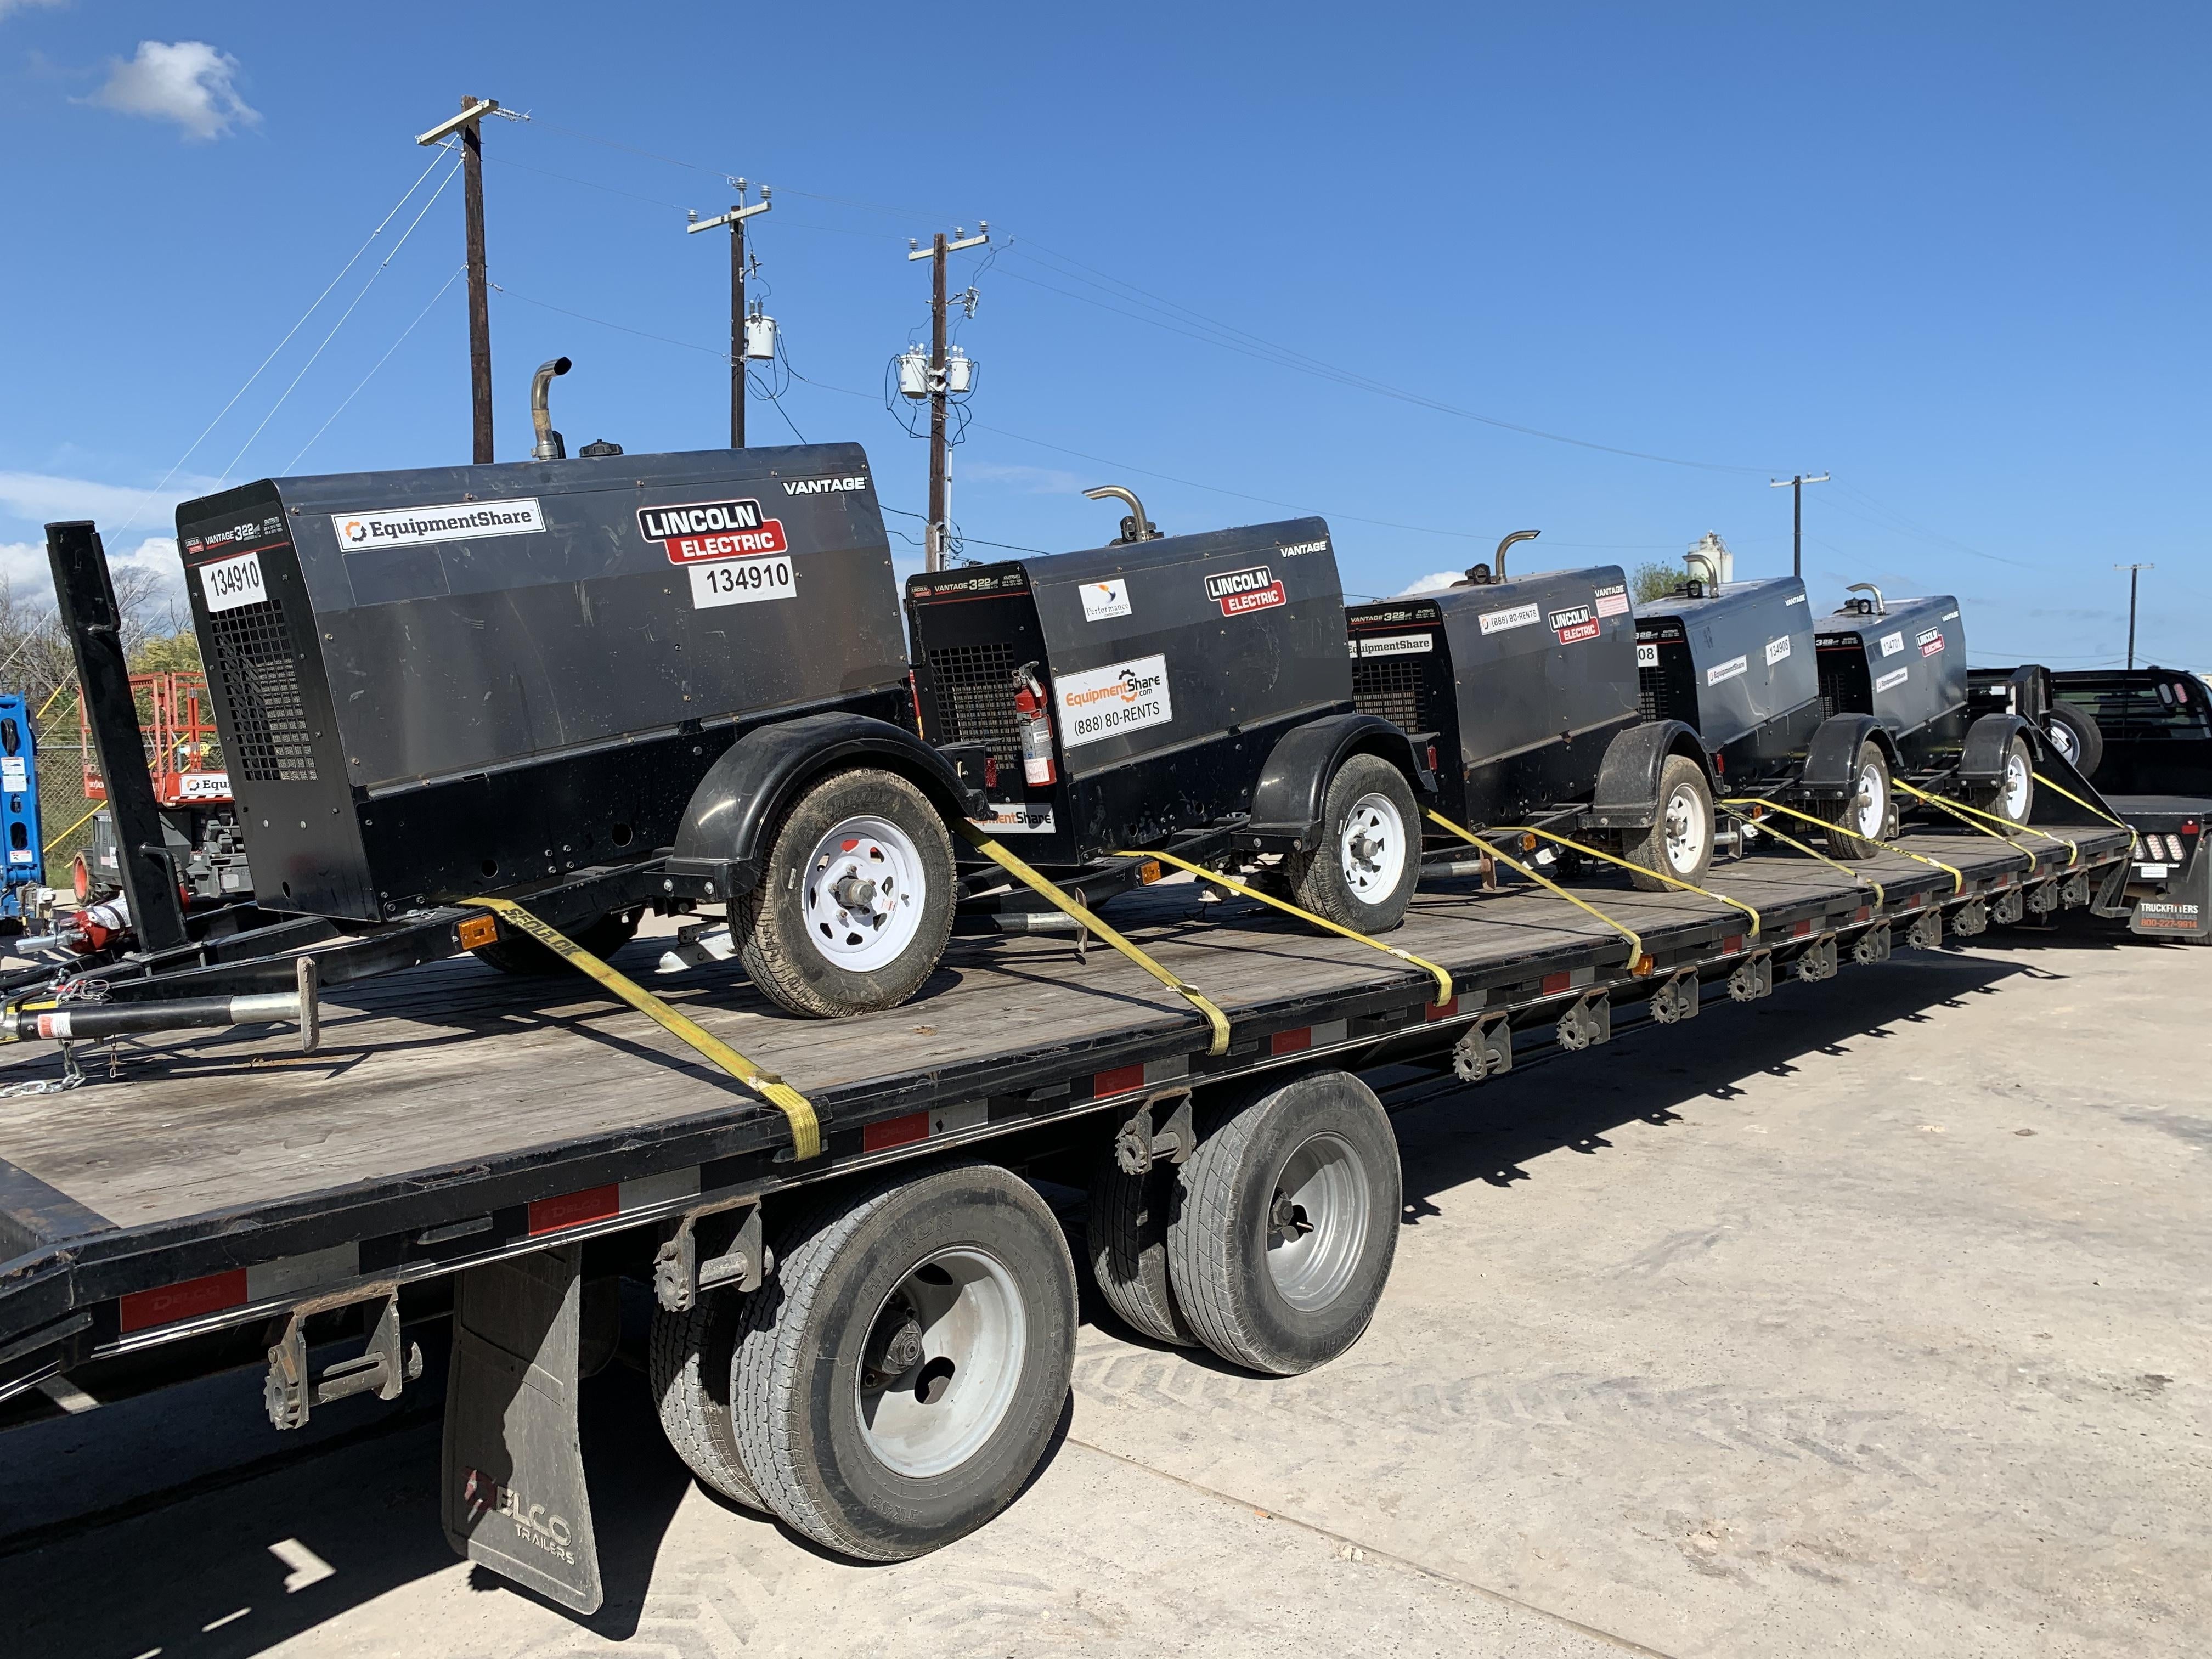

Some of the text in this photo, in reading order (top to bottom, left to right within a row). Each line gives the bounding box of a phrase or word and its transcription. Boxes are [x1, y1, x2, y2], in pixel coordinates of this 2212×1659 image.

[782, 476, 866, 495] VANTAGE
[370, 510, 532, 538] EquipmentShare
[646, 506, 757, 537] LINCOLN
[205, 531, 234, 545] VANTAGE
[234, 523, 253, 541] 322
[680, 533, 774, 558] ELECTRIC
[1280, 541, 1327, 558] VANTAGE
[211, 561, 259, 596] 134910
[706, 563, 789, 594] 134910
[935, 582, 968, 592] VANTAGE
[969, 578, 991, 590] 322
[1209, 571, 1269, 597] LINCOLN
[1595, 585, 1624, 597] VANTAGE
[1785, 594, 1805, 606] VANTAGE
[1086, 603, 1128, 616] Performance
[1228, 590, 1279, 611] ELECTRIC
[1351, 614, 1383, 623] VANTAGE
[1384, 612, 1405, 622] 322
[1491, 610, 1537, 627] (888) 80-RENTS
[1551, 609, 1589, 629] LINCOLN
[1564, 624, 1595, 641] ELECTRIC
[1635, 631, 1652, 639] 322
[1816, 637, 1833, 646] 322
[1917, 628, 1938, 646] LINCOLN
[1770, 639, 1789, 658] 134908
[1924, 641, 1943, 654] ELECTRIC
[1714, 662, 1745, 679] EquipmentShare
[1066, 675, 1160, 707] EquipmentShare
[1138, 688, 1153, 697] .com
[1075, 701, 1160, 736] (888) 80-RENTS
[2141, 902, 2199, 913] TRUCKFITTERS
[2141, 919, 2198, 928] 800-227-9914
[862, 1211, 953, 1300] HI-RUN
[153, 1285, 221, 1311] DELCO
[514, 1523, 575, 1565] TRAILERS
